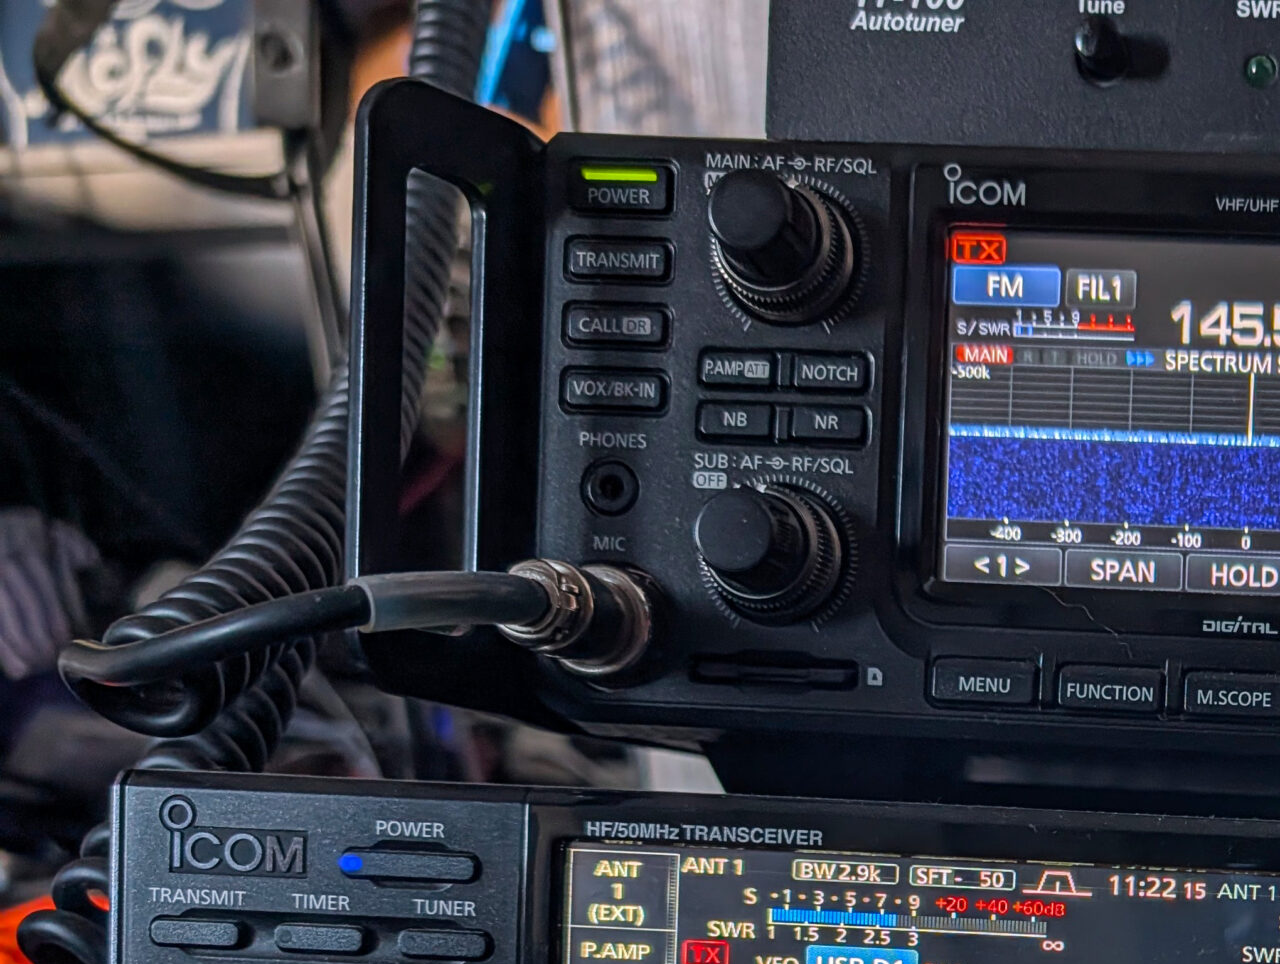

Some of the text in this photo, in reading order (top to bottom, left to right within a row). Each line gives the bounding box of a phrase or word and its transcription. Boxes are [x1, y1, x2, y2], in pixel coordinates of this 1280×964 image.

[850, 10, 965, 32] Autotuner
[814, 156, 877, 174] RF/SQL
[588, 188, 650, 204] POWER
[1216, 198, 1279, 213] VHF/UHF
[577, 251, 660, 270] TRANSMIT
[987, 274, 1024, 298] FM
[1077, 274, 1121, 301] FIL1
[964, 347, 1008, 363] MAIN
[1165, 350, 1272, 375] SPECTRUM
[802, 364, 858, 382] NOTCH
[573, 380, 655, 398] VOX/BK-IN
[723, 411, 747, 427] NB
[815, 414, 838, 430] NR
[579, 432, 647, 449] PHONES
[792, 457, 853, 475] RF/SQL
[593, 536, 626, 551] MIC
[1090, 558, 1155, 583] SPAN
[1211, 563, 1278, 588] HOLD
[959, 676, 1011, 693] MENU
[1067, 683, 1153, 702] FUNCTION
[1197, 689, 1272, 708] M.SCOPE
[376, 821, 444, 838] POWER
[586, 821, 823, 846] HF/50MHz TRANSCEIVER
[593, 860, 643, 878] ANT
[681, 856, 728, 875] ANT
[979, 871, 1005, 888] 50
[1109, 875, 1177, 899] 11:22
[150, 887, 246, 906] TRANSMIT
[1216, 884, 1261, 900] ANT
[292, 893, 350, 911] TIMER
[415, 899, 476, 917] TUNER
[588, 903, 645, 926] (EXT)
[707, 920, 756, 939] SWR
[580, 941, 651, 961] P.AMP
